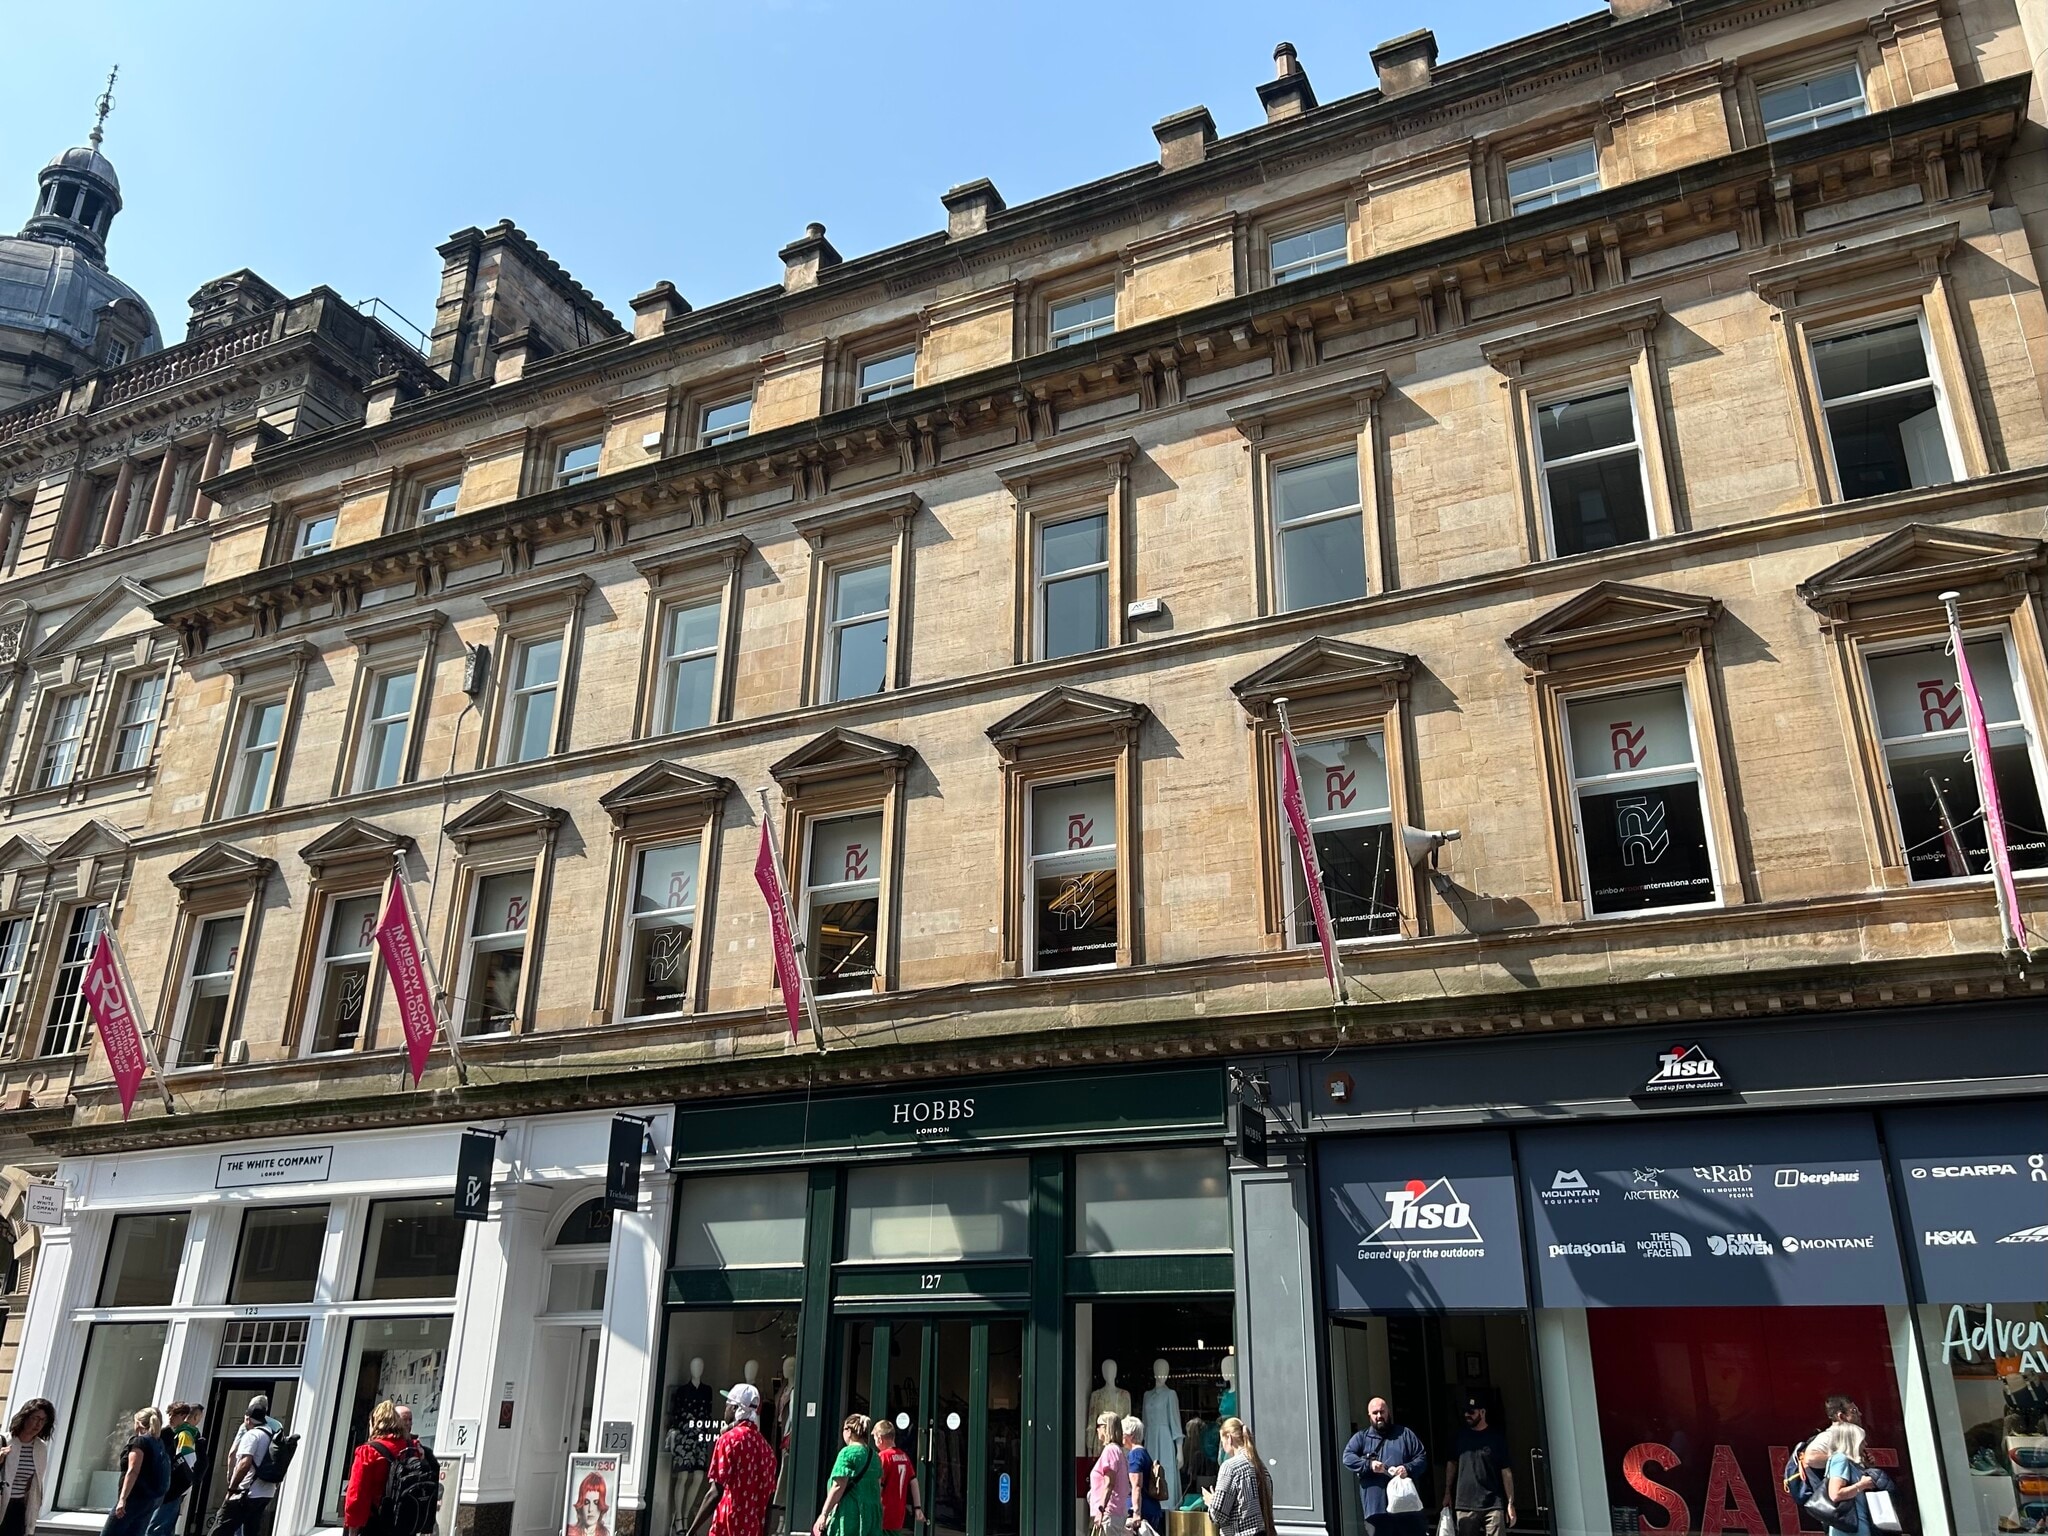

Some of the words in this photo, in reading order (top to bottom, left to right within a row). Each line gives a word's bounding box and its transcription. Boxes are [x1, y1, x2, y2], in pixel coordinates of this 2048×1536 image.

[892, 1098, 975, 1123] HOBBS
[916, 1126, 950, 1134] LONDON
[227, 1161, 244, 1171] THE
[247, 1159, 275, 1169] WHITE
[277, 1155, 324, 1168] COMPANY
[1711, 1165, 1752, 1183] Rab
[1800, 1170, 1859, 1185] berghaus
[1931, 1164, 2017, 1178] SCARPA
[1542, 1189, 1600, 1198] MOUNTAIN
[32, 1204, 58, 1212] COMPANY
[1385, 1191, 1470, 1230] Tiso
[1650, 1232, 1670, 1241] THE
[1801, 1237, 1874, 1249] MONTANE
[1925, 1230, 1978, 1246] HOKA
[1549, 1241, 1626, 1258] patagonia
[1637, 1241, 1671, 1250] NORTH
[1358, 1249, 1392, 1260] Geared
[1393, 1250, 1406, 1261] up
[1405, 1248, 1422, 1261] for
[1422, 1248, 1439, 1258] the
[1440, 1247, 1485, 1258] outdoors
[1647, 1249, 1672, 1257] FACE
[920, 1274, 942, 1290] 127
[245, 1307, 259, 1315] 123
[389, 1393, 419, 1404] SALE
[605, 1433, 628, 1449] 125
[598, 1461, 616, 1471] £30
[1622, 1443, 1899, 1536] SAL
